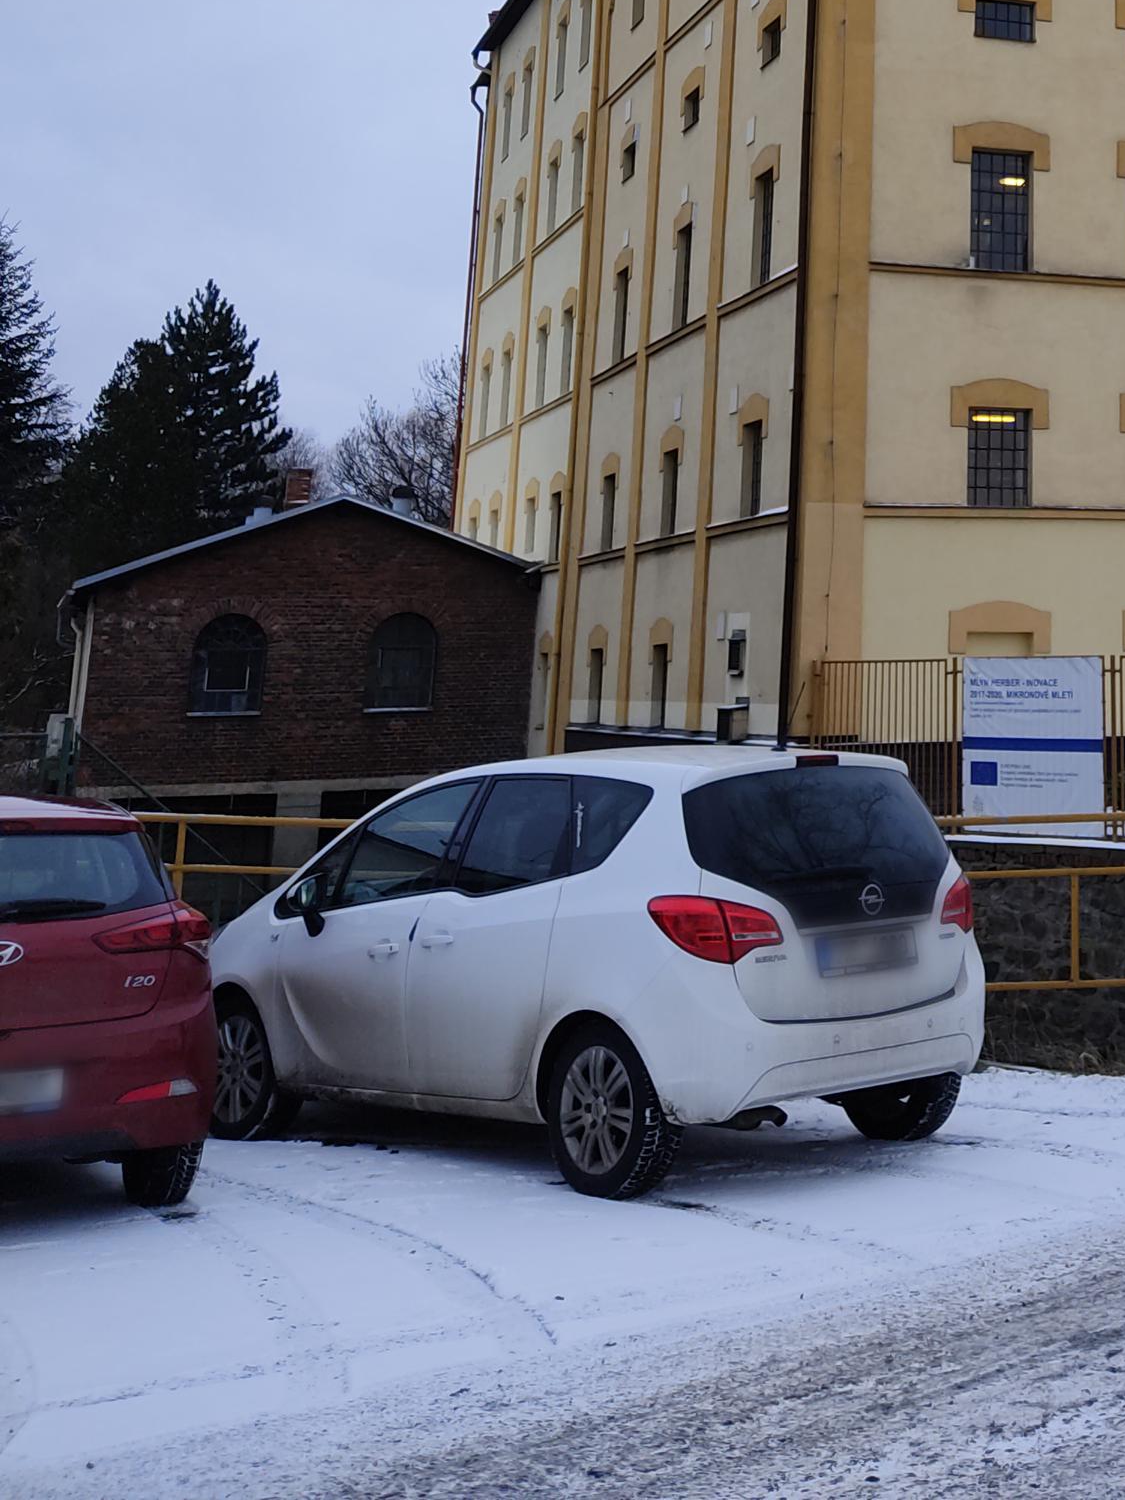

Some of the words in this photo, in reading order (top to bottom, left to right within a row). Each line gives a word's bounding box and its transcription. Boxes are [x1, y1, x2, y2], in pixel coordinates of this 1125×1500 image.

[991, 678, 1020, 687] HERBER
[1026, 678, 1058, 687] INOVACE
[1006, 689, 1049, 699] MIKRONOVÉ
